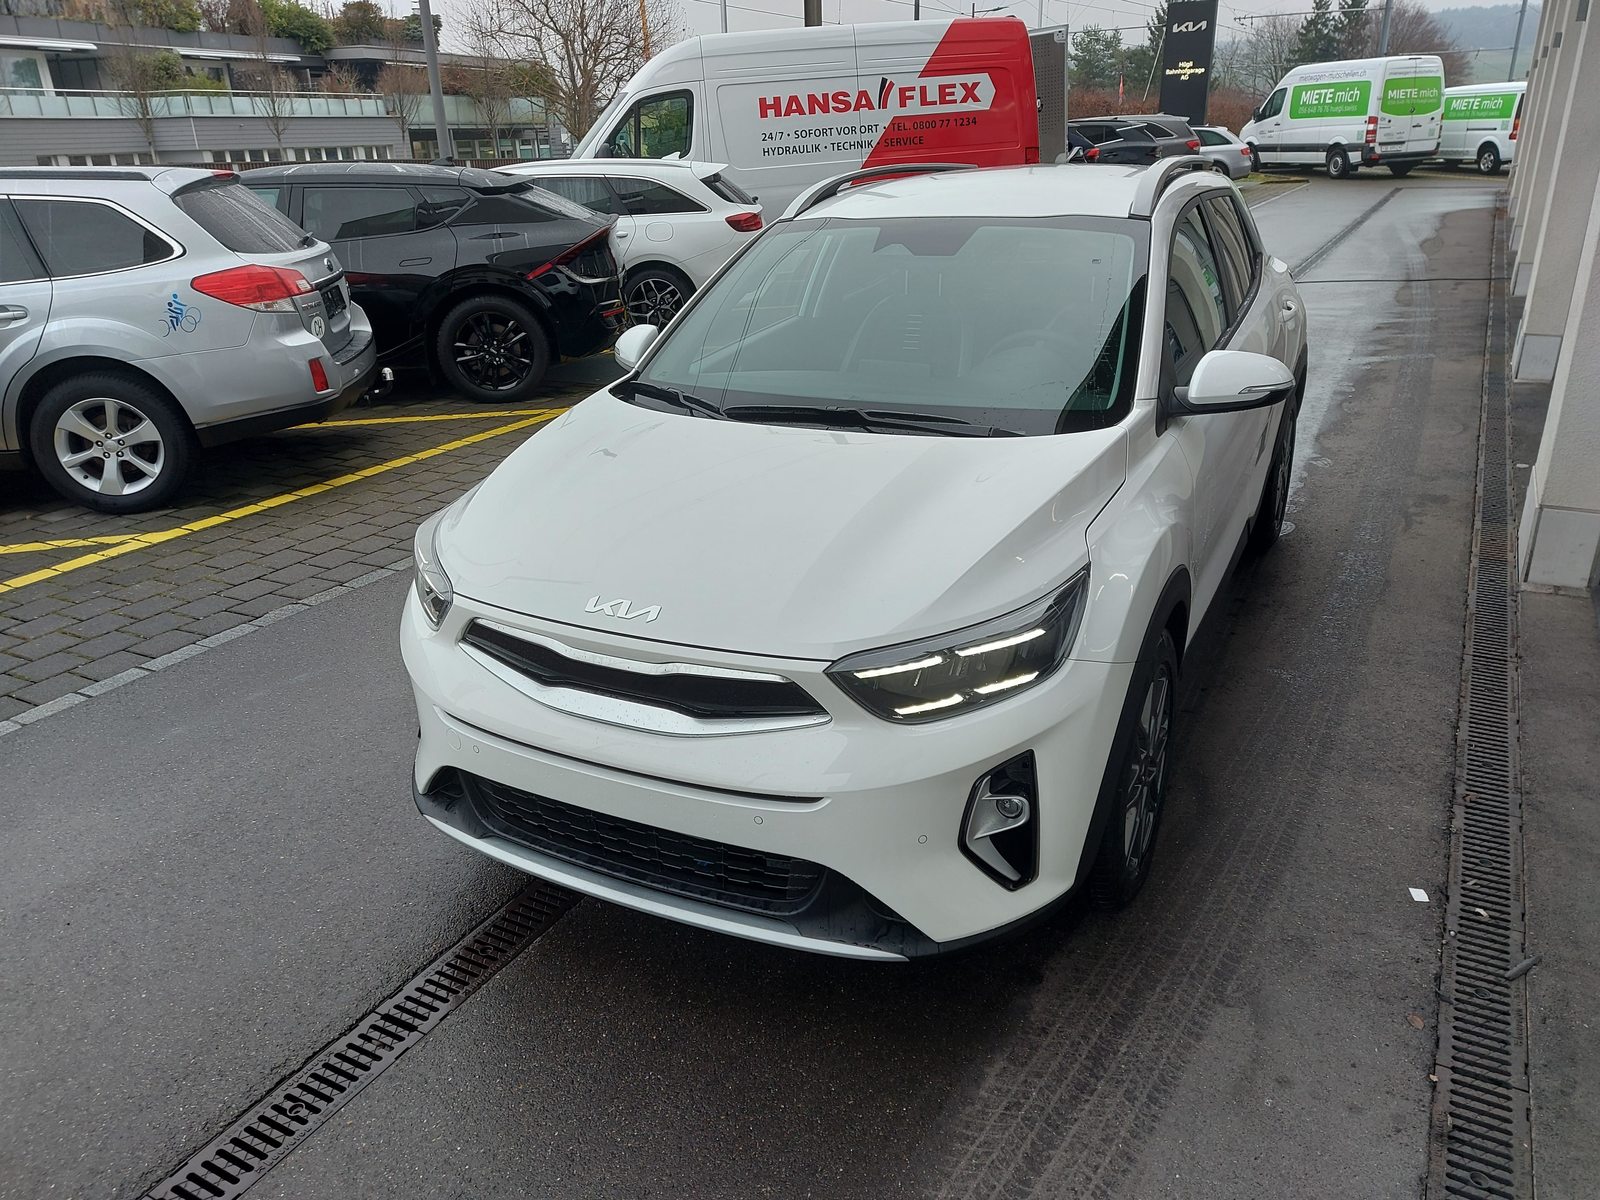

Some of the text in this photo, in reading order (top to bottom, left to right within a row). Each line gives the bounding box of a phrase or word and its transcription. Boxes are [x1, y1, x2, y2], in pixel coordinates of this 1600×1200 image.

[1173, 20, 1207, 33] KIA
[758, 81, 981, 119] HANSA FLEX
[1300, 87, 1361, 105] MIETE mich
[1388, 87, 1439, 100] MIETE mich
[1450, 98, 1482, 111] MIETE
[1481, 97, 1503, 110] mich
[761, 116, 977, 142] 24/7 SOFORT VOR ORT TEL. 0800 77 1234
[762, 136, 925, 157] HYDRAULIK TECHNIK SERVICE
[584, 594, 663, 624] KIA
